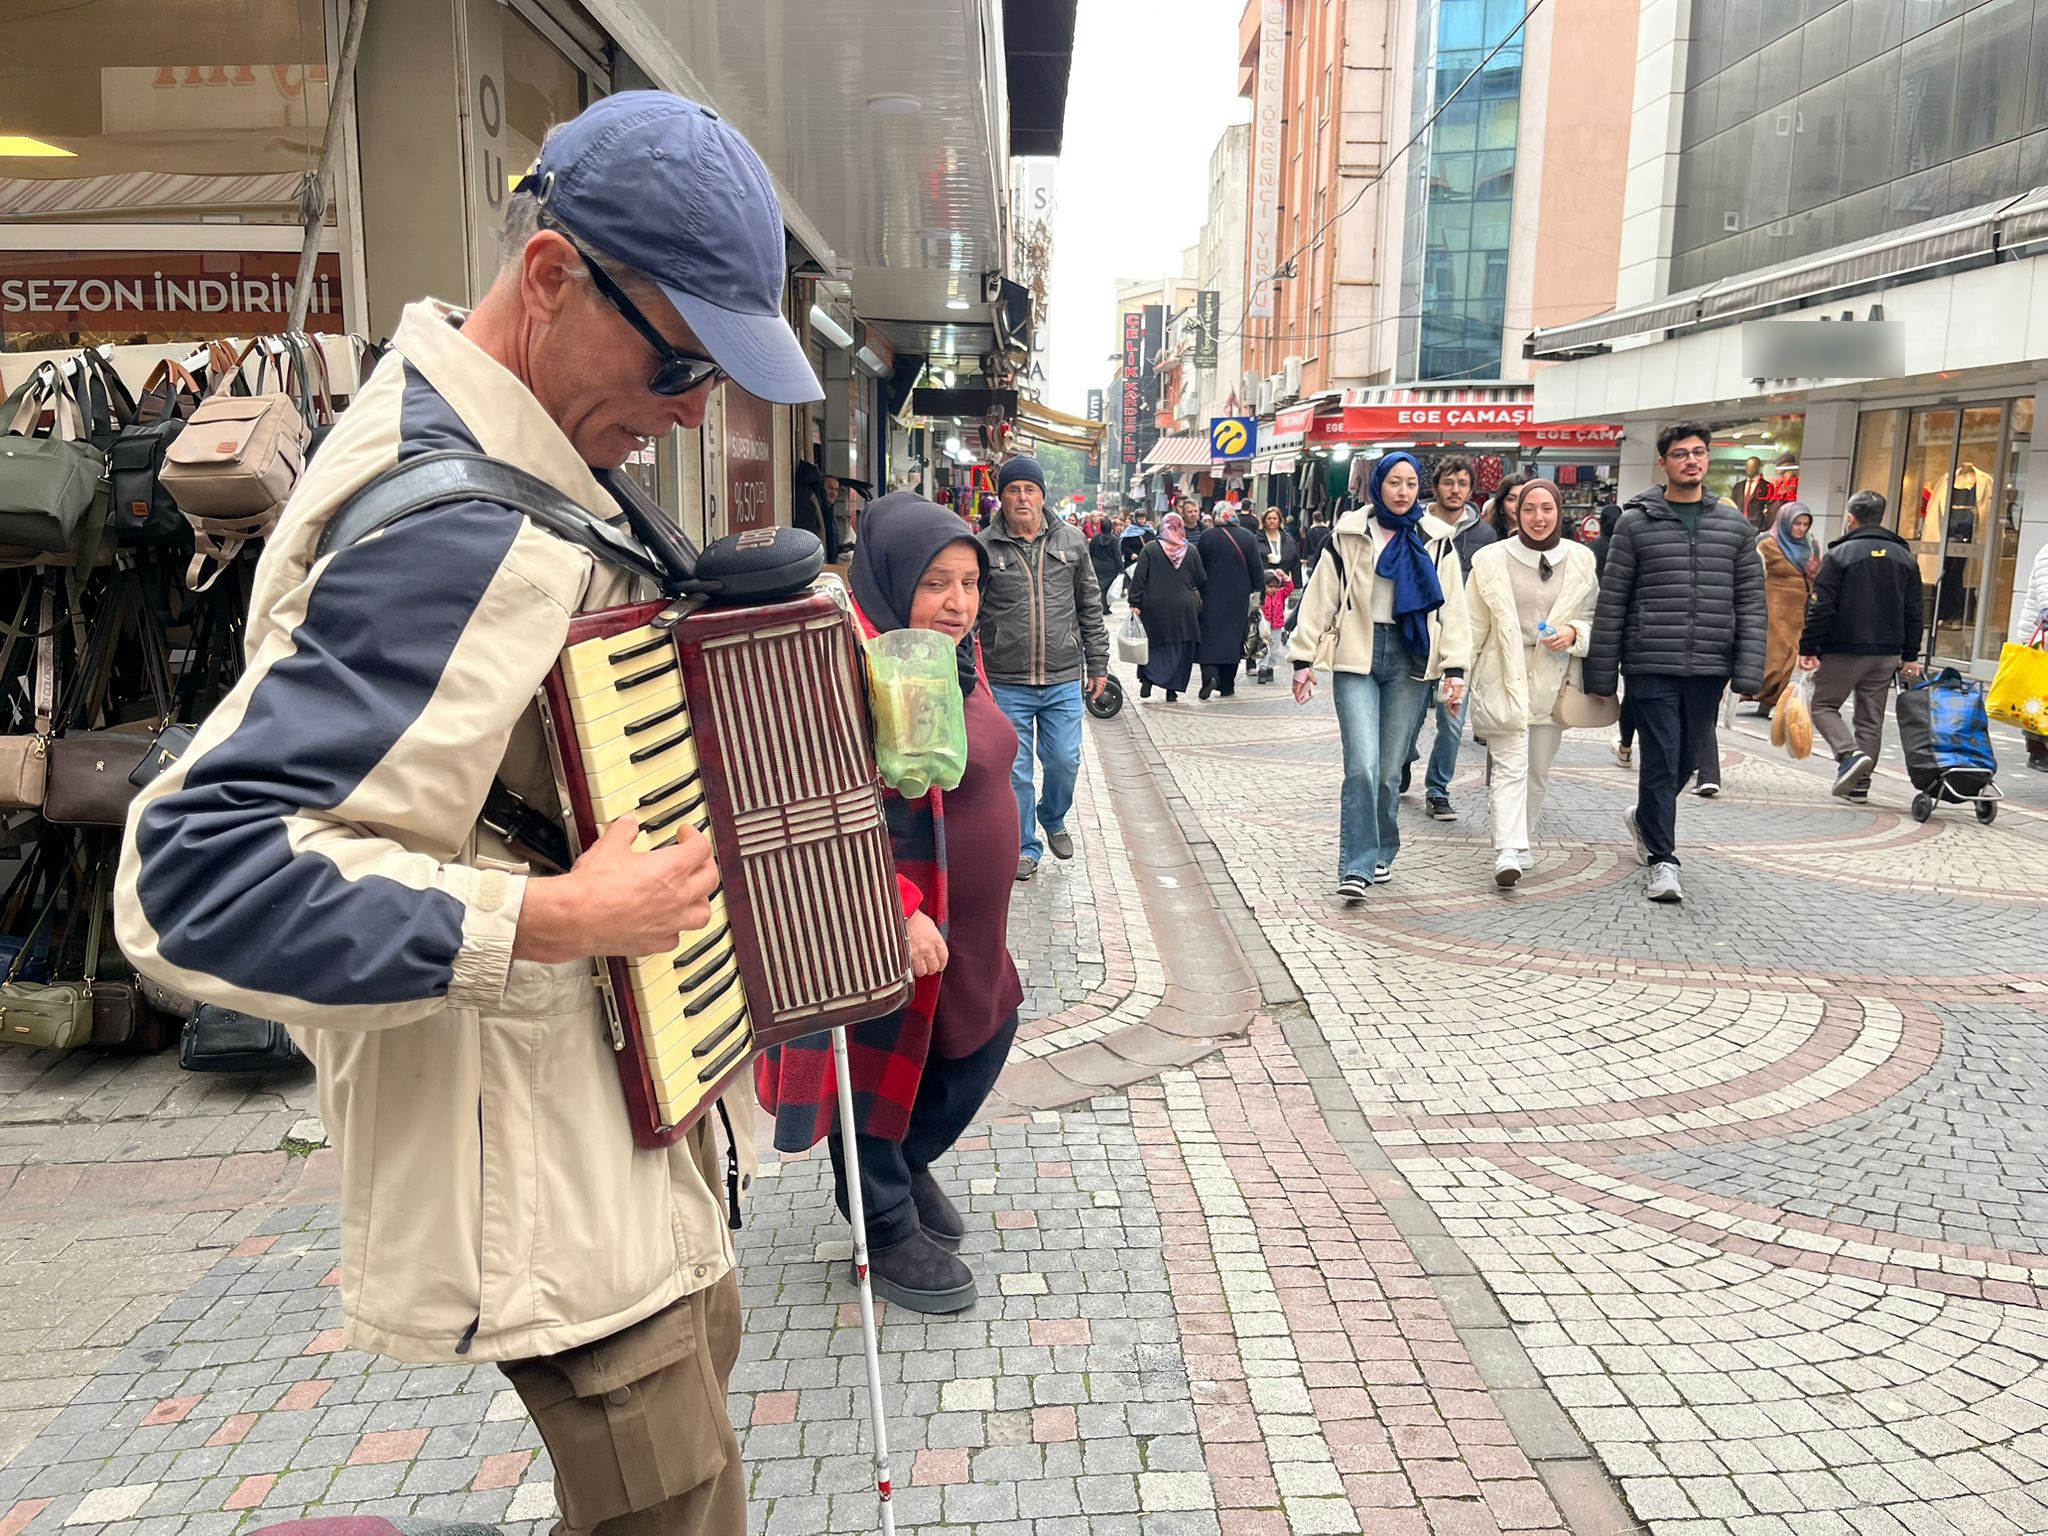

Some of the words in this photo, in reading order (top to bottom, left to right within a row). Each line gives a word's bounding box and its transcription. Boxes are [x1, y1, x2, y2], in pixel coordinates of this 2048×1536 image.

[1, 278, 144, 312] SEZON
[1325, 423, 1344, 433] EGE
[1397, 410, 1440, 424] EGE
[1446, 408, 1533, 427] ÇAMAŞI
[731, 431, 750, 459] SÜPER
[1536, 430, 1571, 440] EGE
[734, 481, 756, 523] %50
